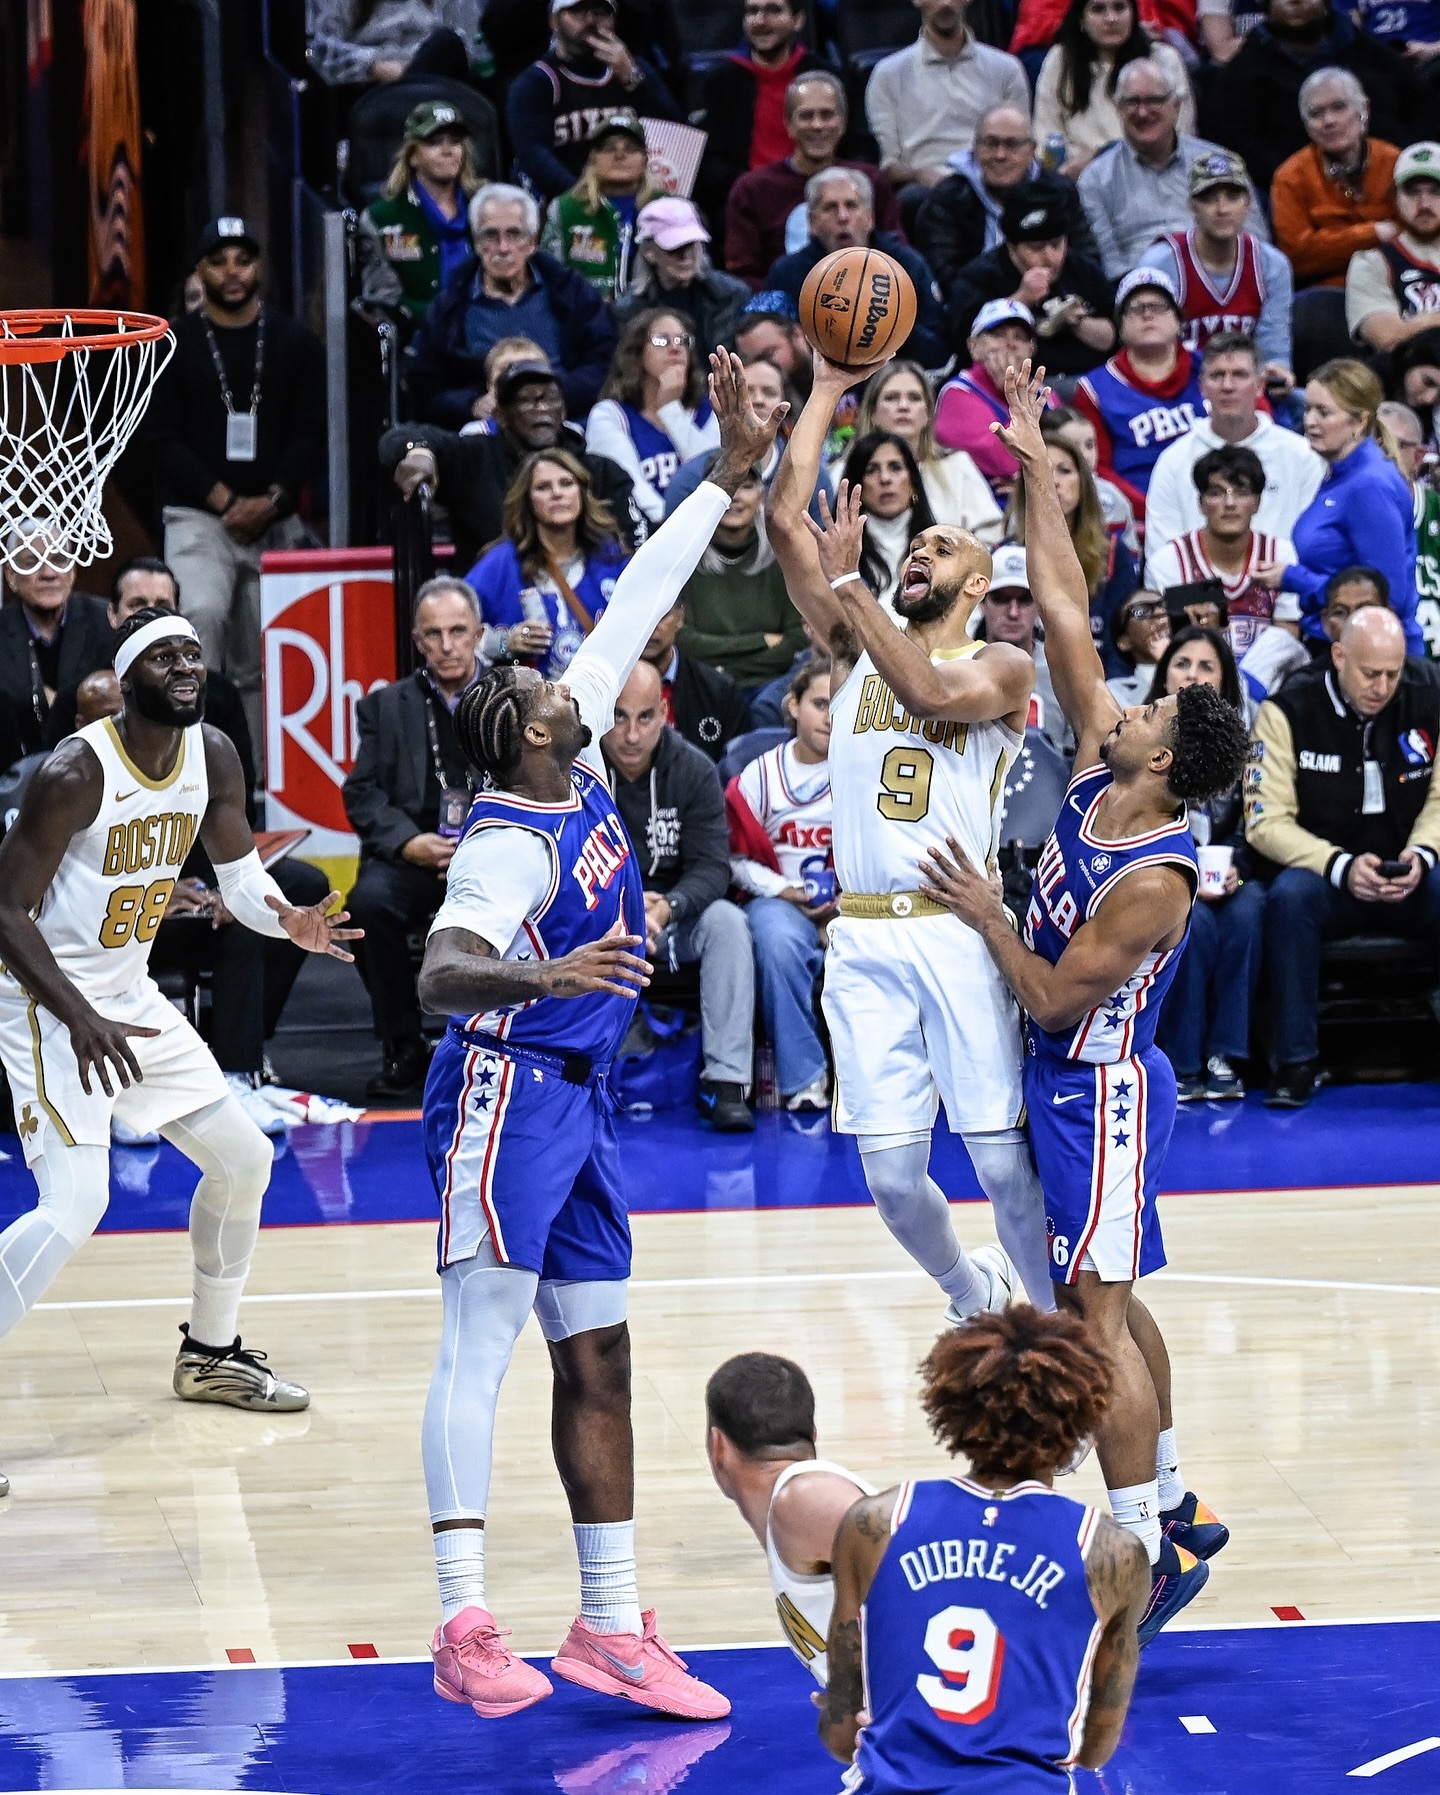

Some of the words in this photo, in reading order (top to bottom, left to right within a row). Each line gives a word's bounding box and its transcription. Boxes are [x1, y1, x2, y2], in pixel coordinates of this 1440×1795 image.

[856, 273, 891, 348] Wilson
[264, 582, 390, 793] Rh
[876, 746, 935, 823] 9
[1299, 750, 1341, 774] SLAM
[101, 811, 198, 876] BOSTON
[98, 876, 176, 949] 88
[1038, 833, 1079, 940] HILA
[1009, 1553, 1067, 1610] JR.
[915, 1604, 1006, 1726] 9
